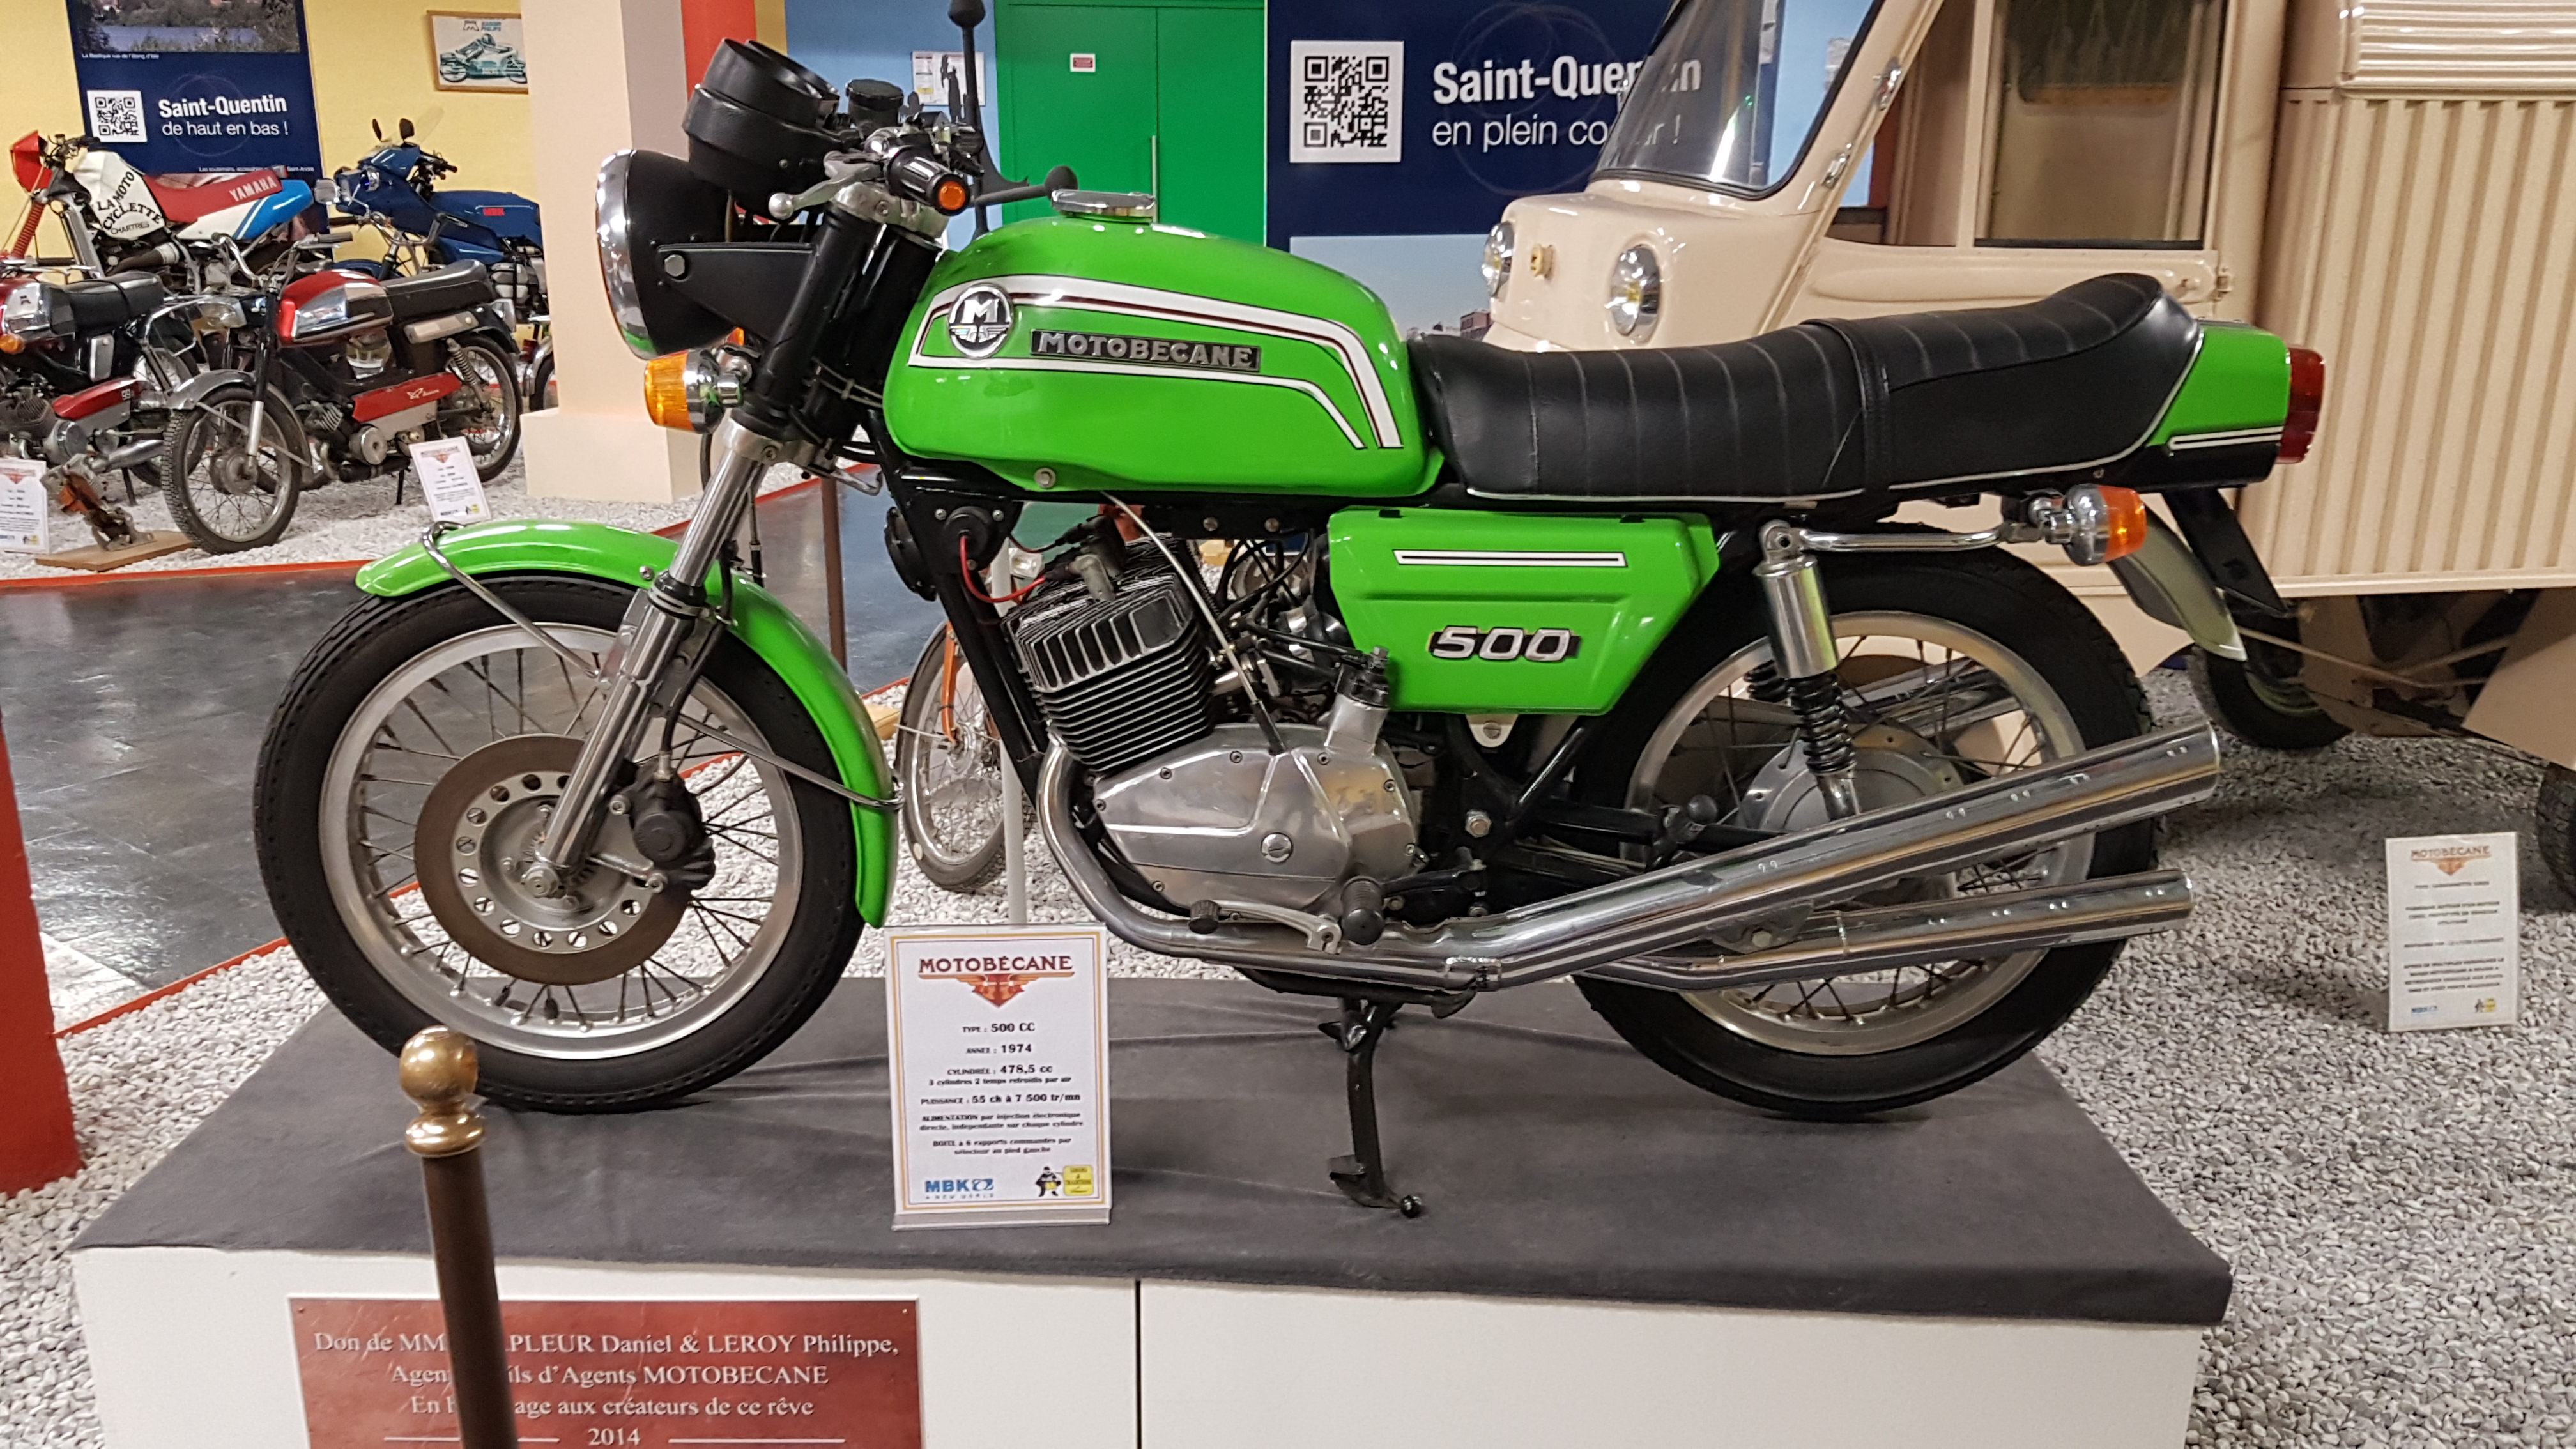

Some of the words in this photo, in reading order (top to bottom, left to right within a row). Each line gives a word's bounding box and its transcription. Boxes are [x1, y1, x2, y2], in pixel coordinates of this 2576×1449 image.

[1432, 56, 1702, 105] Saint-Quen
[158, 95, 287, 118] Saint-Quentin
[162, 121, 183, 136] de
[187, 121, 221, 135] haut
[226, 125, 246, 135] en
[251, 121, 280, 135] bas
[284, 121, 289, 135] !
[1432, 120, 1471, 146] en
[1483, 114, 1558, 153] plein
[96, 199, 116, 211] LA
[112, 171, 135, 206] MOTO
[229, 176, 277, 202] YAMAHA
[103, 203, 162, 230] CYCLETTE
[1432, 625, 1572, 661] 500
[918, 955, 1073, 973] MOTOBÉCANE
[991, 1023, 1015, 1032] 500
[1019, 1022, 1036, 1032] CC
[1000, 1043, 1032, 1054] 1974
[1000, 1064, 1036, 1075] 478,5
[972, 1095, 986, 1104] 55
[990, 1095, 1002, 1103] ch
[1015, 1094, 1022, 1102] 7
[1026, 1094, 1047, 1102] 500
[1050, 1092, 1081, 1102] tr/mn
[1022, 1121, 1050, 1129] chaque
[925, 1179, 969, 1192] MBK
[314, 1333, 360, 1351] Don
[366, 1333, 394, 1351] de
[602, 1335, 673, 1353] Daniel
[679, 1335, 700, 1353] &
[708, 1335, 797, 1353] LEROY
[803, 1334, 899, 1357] Philippe,
[392, 1366, 452, 1387] Agen
[509, 1365, 532, 1383] ils
[644, 1365, 829, 1384] MOTOBECANE
[411, 1395, 442, 1413] En
[558, 1400, 596, 1414] aux
[602, 1398, 700, 1415] créateurs
[705, 1397, 732, 1415] de
[737, 1402, 762, 1415] ce
[768, 1397, 815, 1415] rêve
[588, 1427, 641, 1446] 2014
